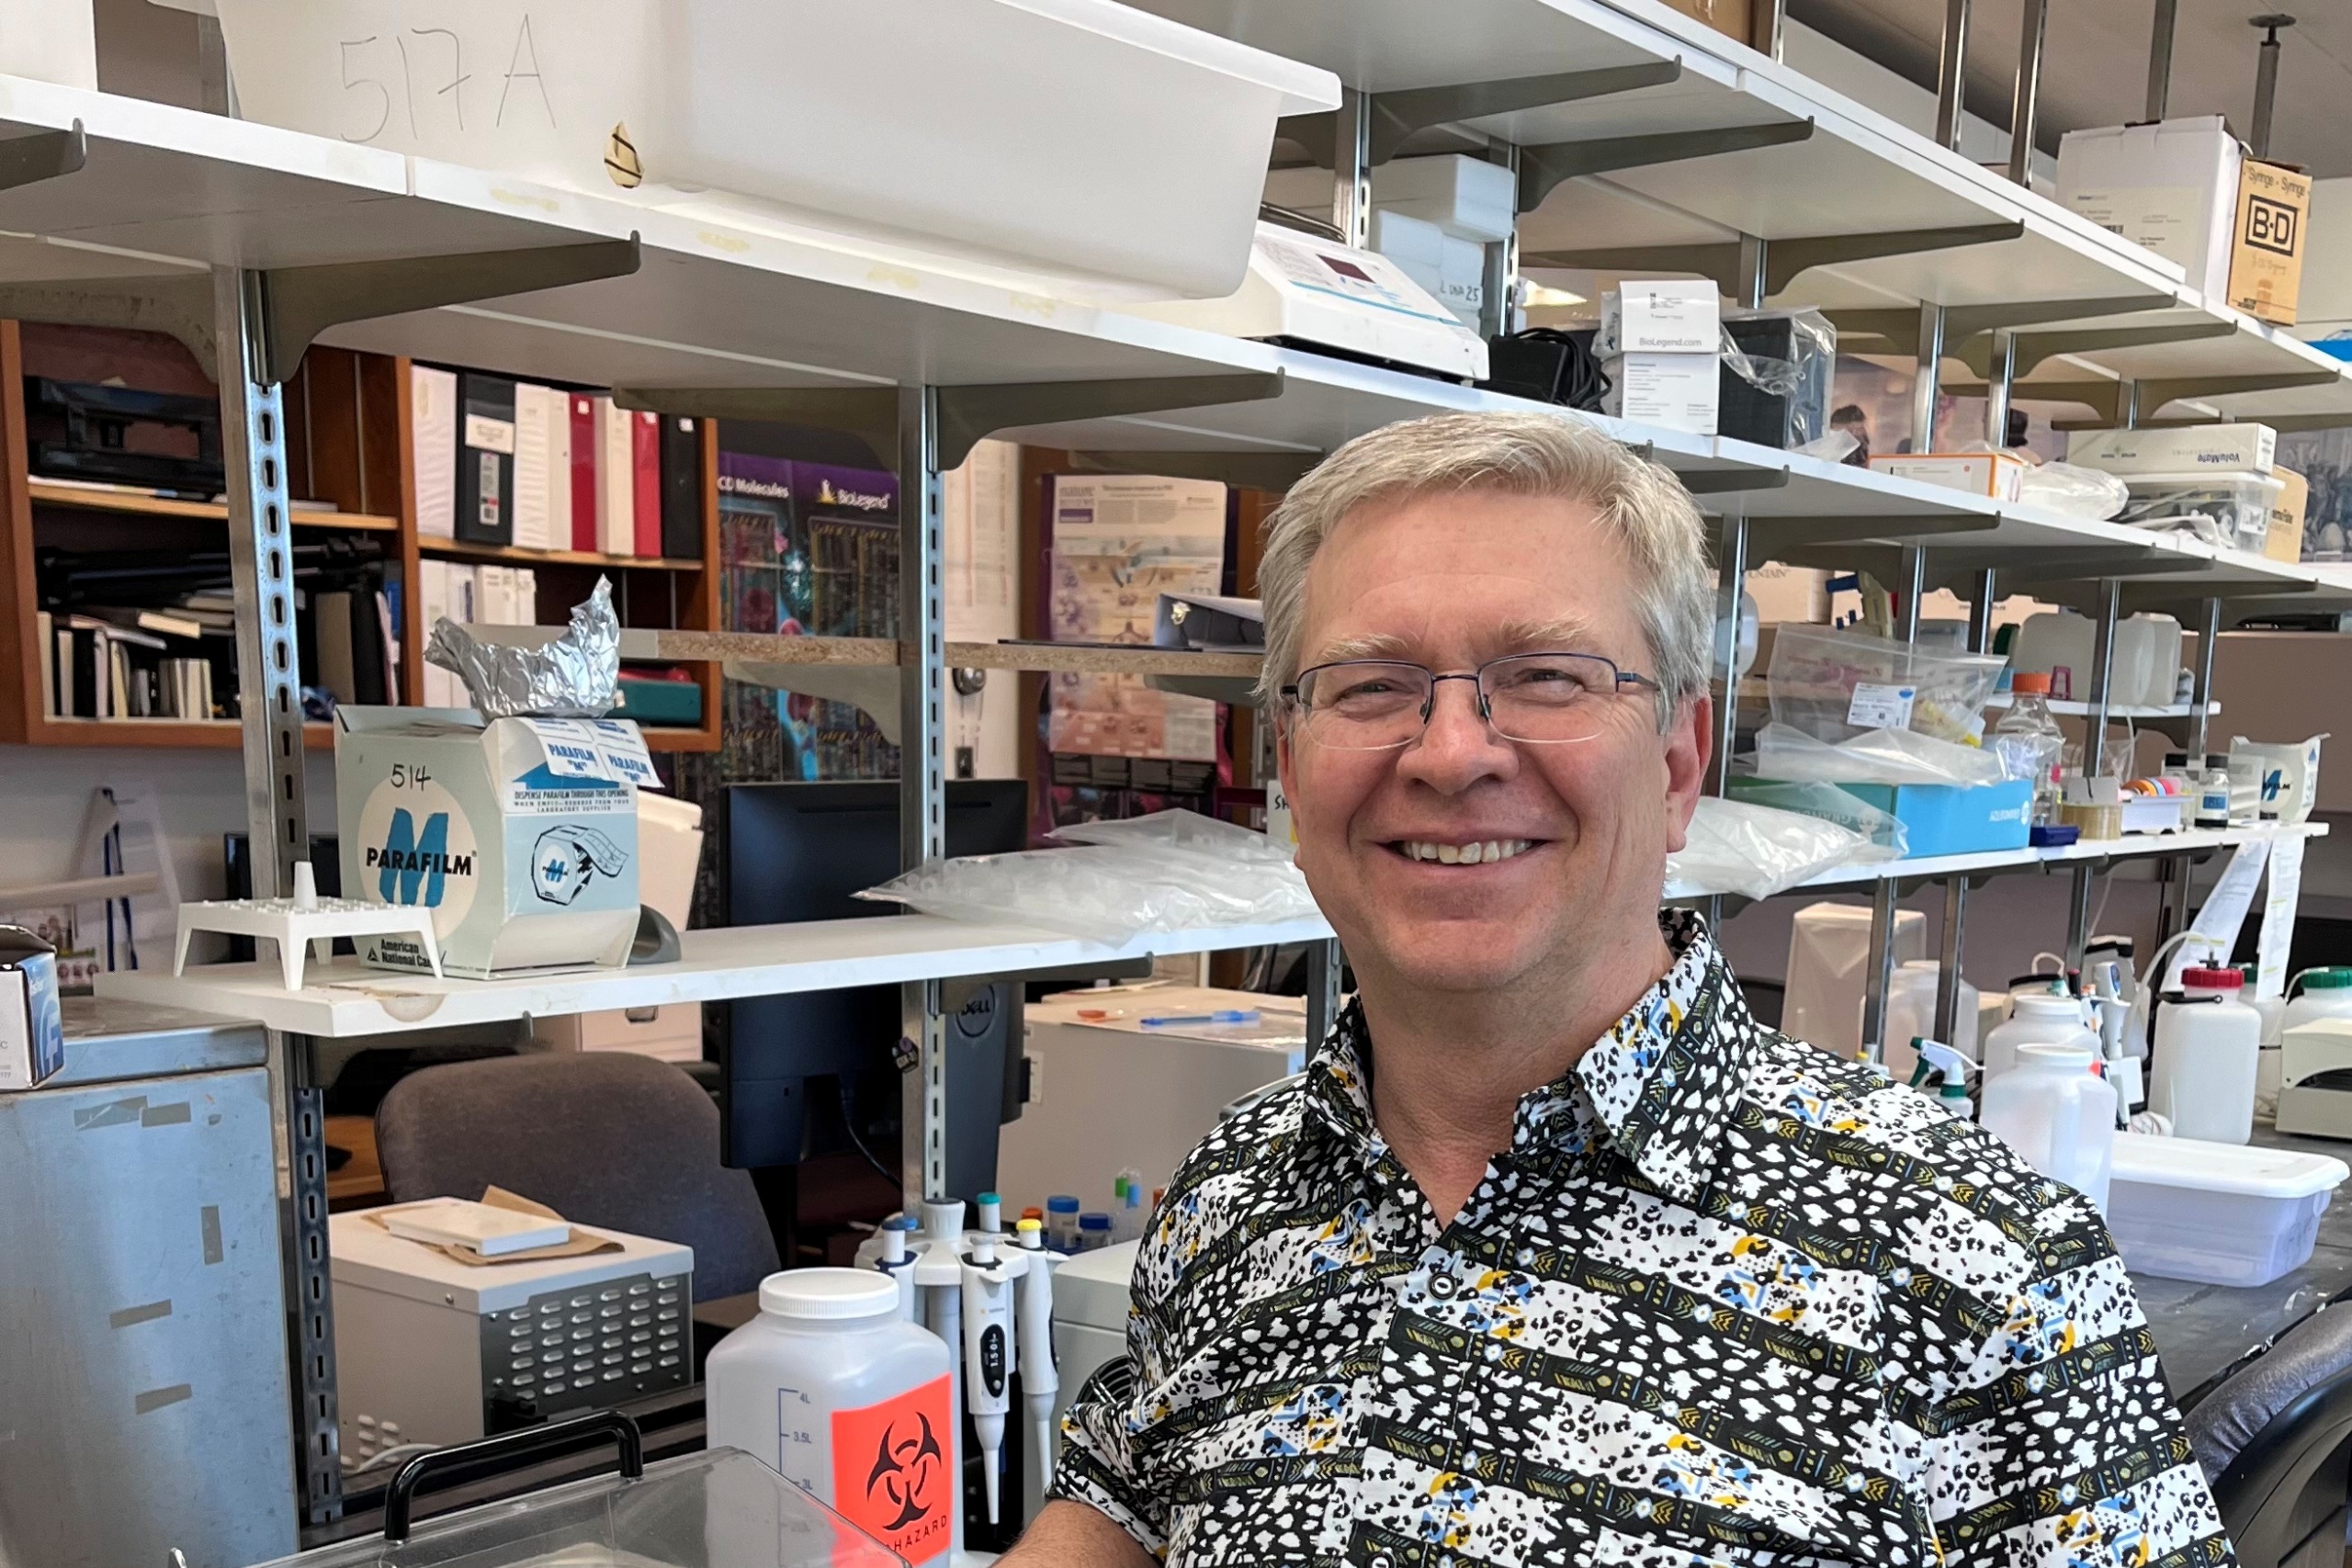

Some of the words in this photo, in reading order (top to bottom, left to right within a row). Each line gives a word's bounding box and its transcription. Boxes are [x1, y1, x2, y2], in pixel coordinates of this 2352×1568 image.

[341, 28, 471, 143] 517
[496, 13, 556, 129] A
[1639, 337, 1702, 348] BioLegend.com
[736, 478, 790, 498] Molecules
[548, 743, 597, 762] PARAFILM
[607, 754, 650, 775] PARAFILM
[390, 763, 432, 792] 514
[514, 790, 542, 800] DISPENSE
[542, 790, 570, 800] PARAFILM
[571, 789, 595, 798] THROUGH
[595, 789, 607, 798] THIS
[607, 788, 628, 797] OPENING
[366, 846, 471, 876] PARAFILM
[380, 939, 420, 953] American
[381, 951, 415, 965] National
[799, 1393, 811, 1404] 4L
[793, 1430, 812, 1443] 3.5L
[802, 1479, 813, 1490] 3L
[887, 1515, 947, 1551] HAZARD
